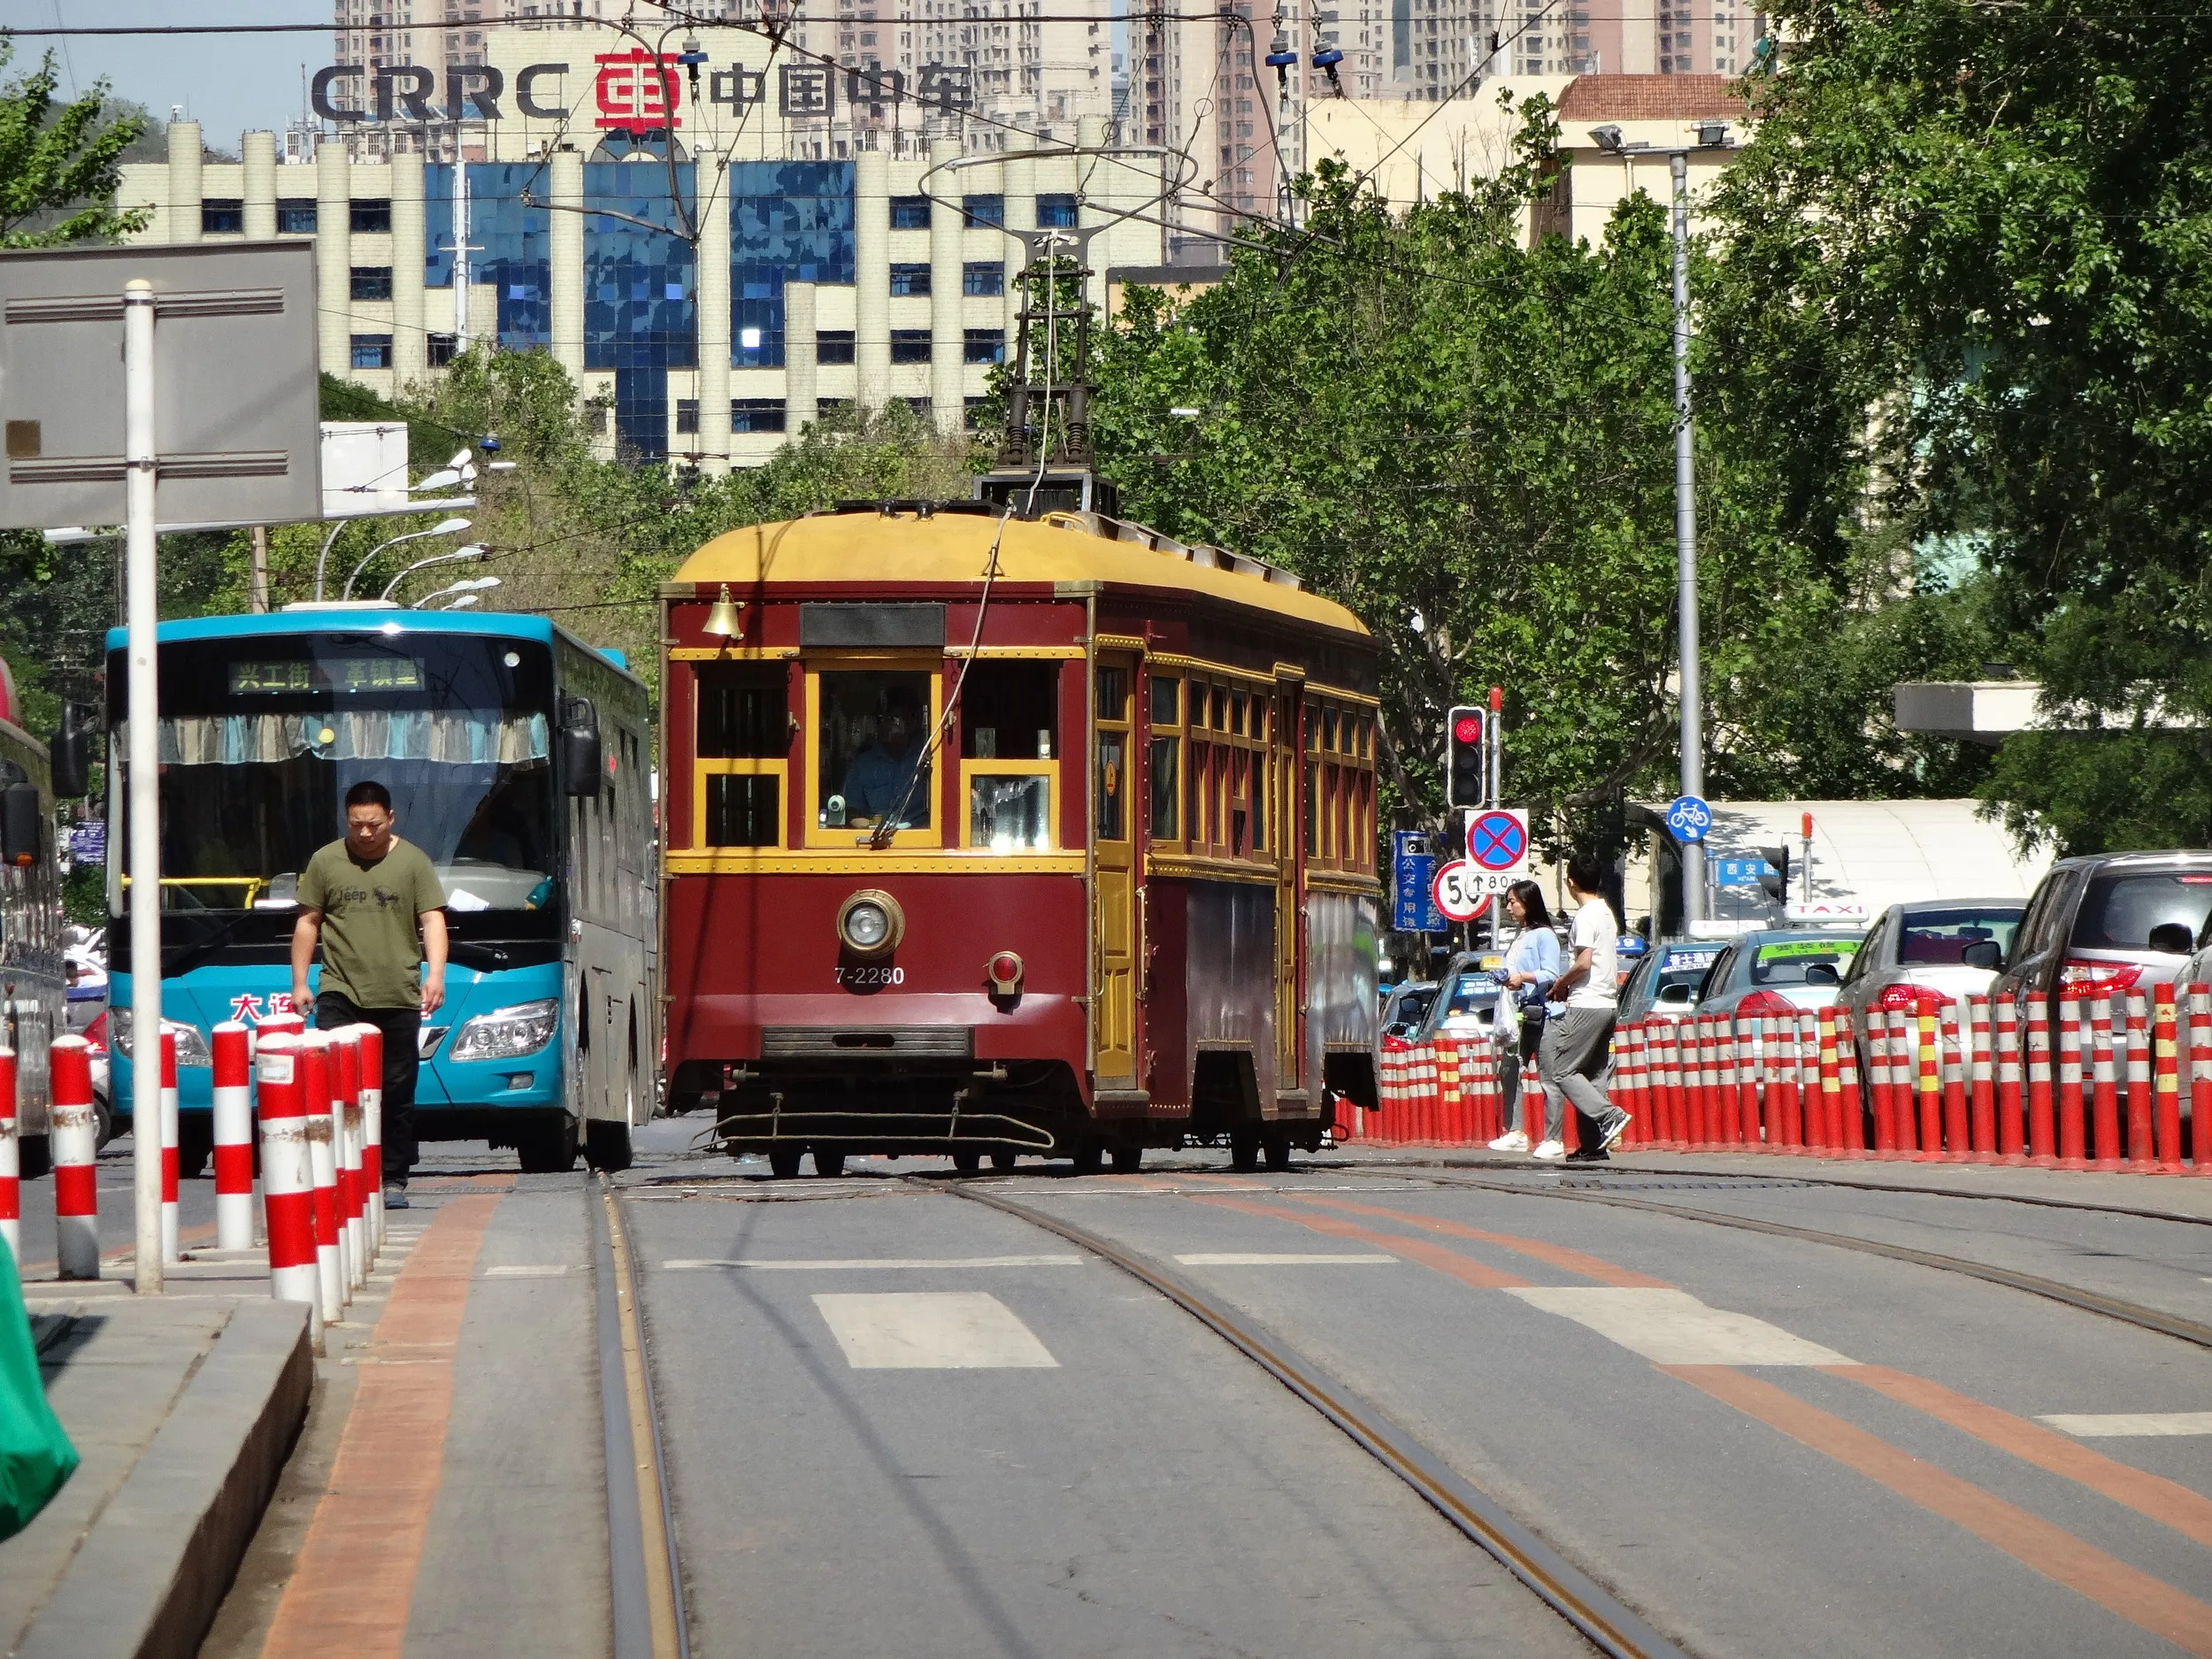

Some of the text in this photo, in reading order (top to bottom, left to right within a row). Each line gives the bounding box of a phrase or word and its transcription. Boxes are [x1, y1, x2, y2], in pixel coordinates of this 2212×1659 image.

[311, 63, 571, 120] CRRC
[710, 62, 973, 117] 中国中车
[238, 663, 310, 687] 兴工街
[335, 889, 368, 903] Jeep
[1793, 905, 1863, 914] TAXI
[834, 966, 904, 984] 7-2280
